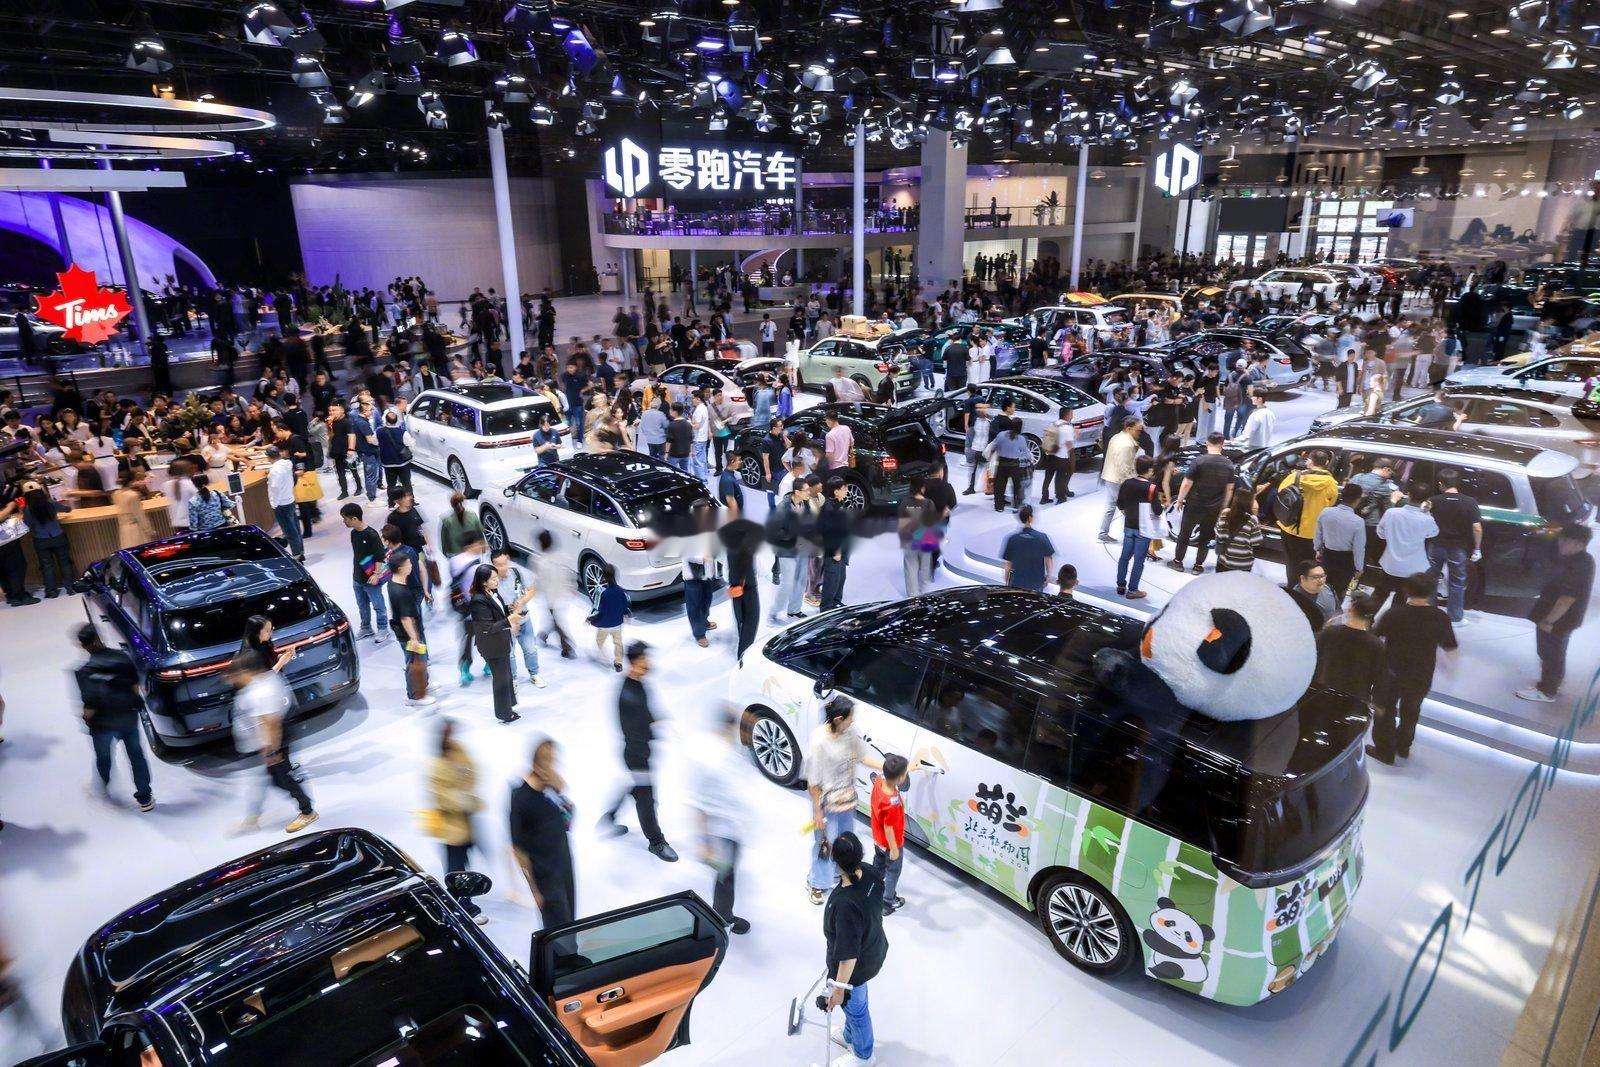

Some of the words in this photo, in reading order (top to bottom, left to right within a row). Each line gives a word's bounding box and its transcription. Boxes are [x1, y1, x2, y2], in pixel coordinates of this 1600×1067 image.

[658, 147, 796, 190] 零跑汽车
[54, 298, 119, 330] Tims
[1010, 859, 1029, 873] ZOO
